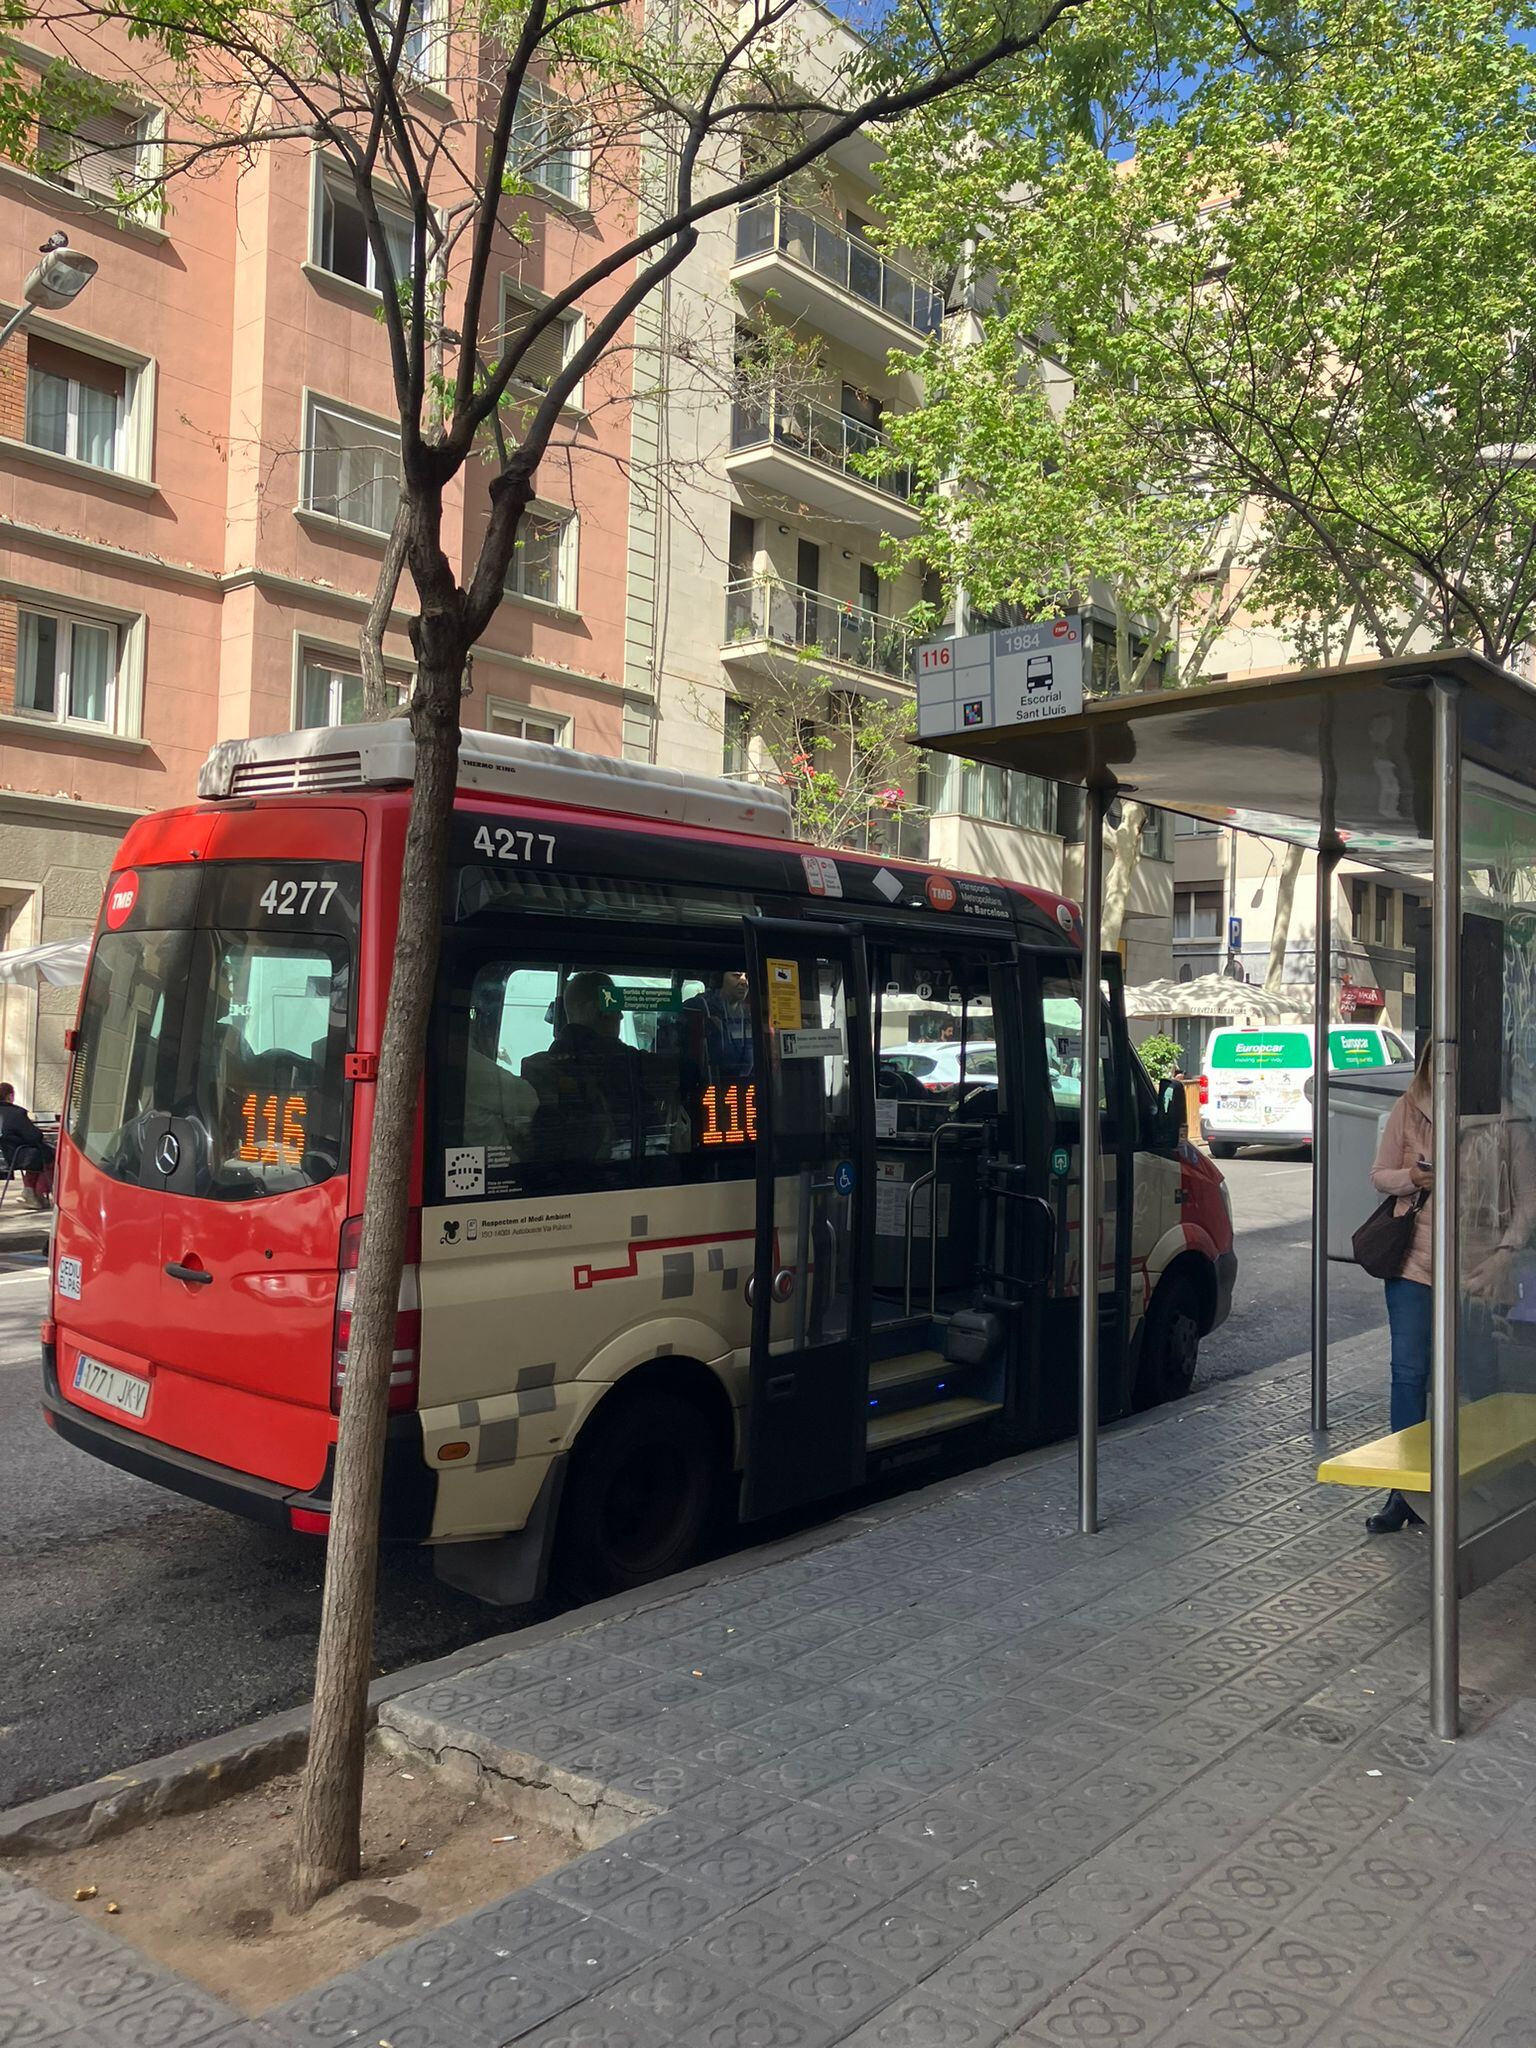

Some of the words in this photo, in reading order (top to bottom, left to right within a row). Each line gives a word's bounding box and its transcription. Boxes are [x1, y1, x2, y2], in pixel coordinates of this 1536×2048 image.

[1005, 633, 1041, 653] 1984
[922, 648, 950, 668] 116
[1020, 691, 1062, 706] Escorial
[1016, 708, 1039, 721] Sant
[1043, 704, 1067, 717] Lluís
[463, 760, 494, 770] THERMO
[496, 765, 516, 773] KING
[473, 825, 556, 864] 4277
[111, 891, 133, 909] TMB
[259, 879, 339, 915] 4277
[931, 887, 953, 901] TMB
[964, 904, 973, 913] de
[974, 905, 1010, 918] Barcelona
[1231, 920, 1240, 945] P
[1235, 1043, 1285, 1054] Europcar
[1340, 1036, 1368, 1050] Europcar
[240, 1094, 307, 1165] 116
[481, 1218, 518, 1228] Respectem
[520, 1217, 527, 1225] el
[528, 1215, 544, 1224] Medi
[545, 1213, 571, 1222] Ambient
[68, 1278, 81, 1294] PAS
[84, 1362, 115, 1399] 1771
[117, 1377, 146, 1412] JKV
